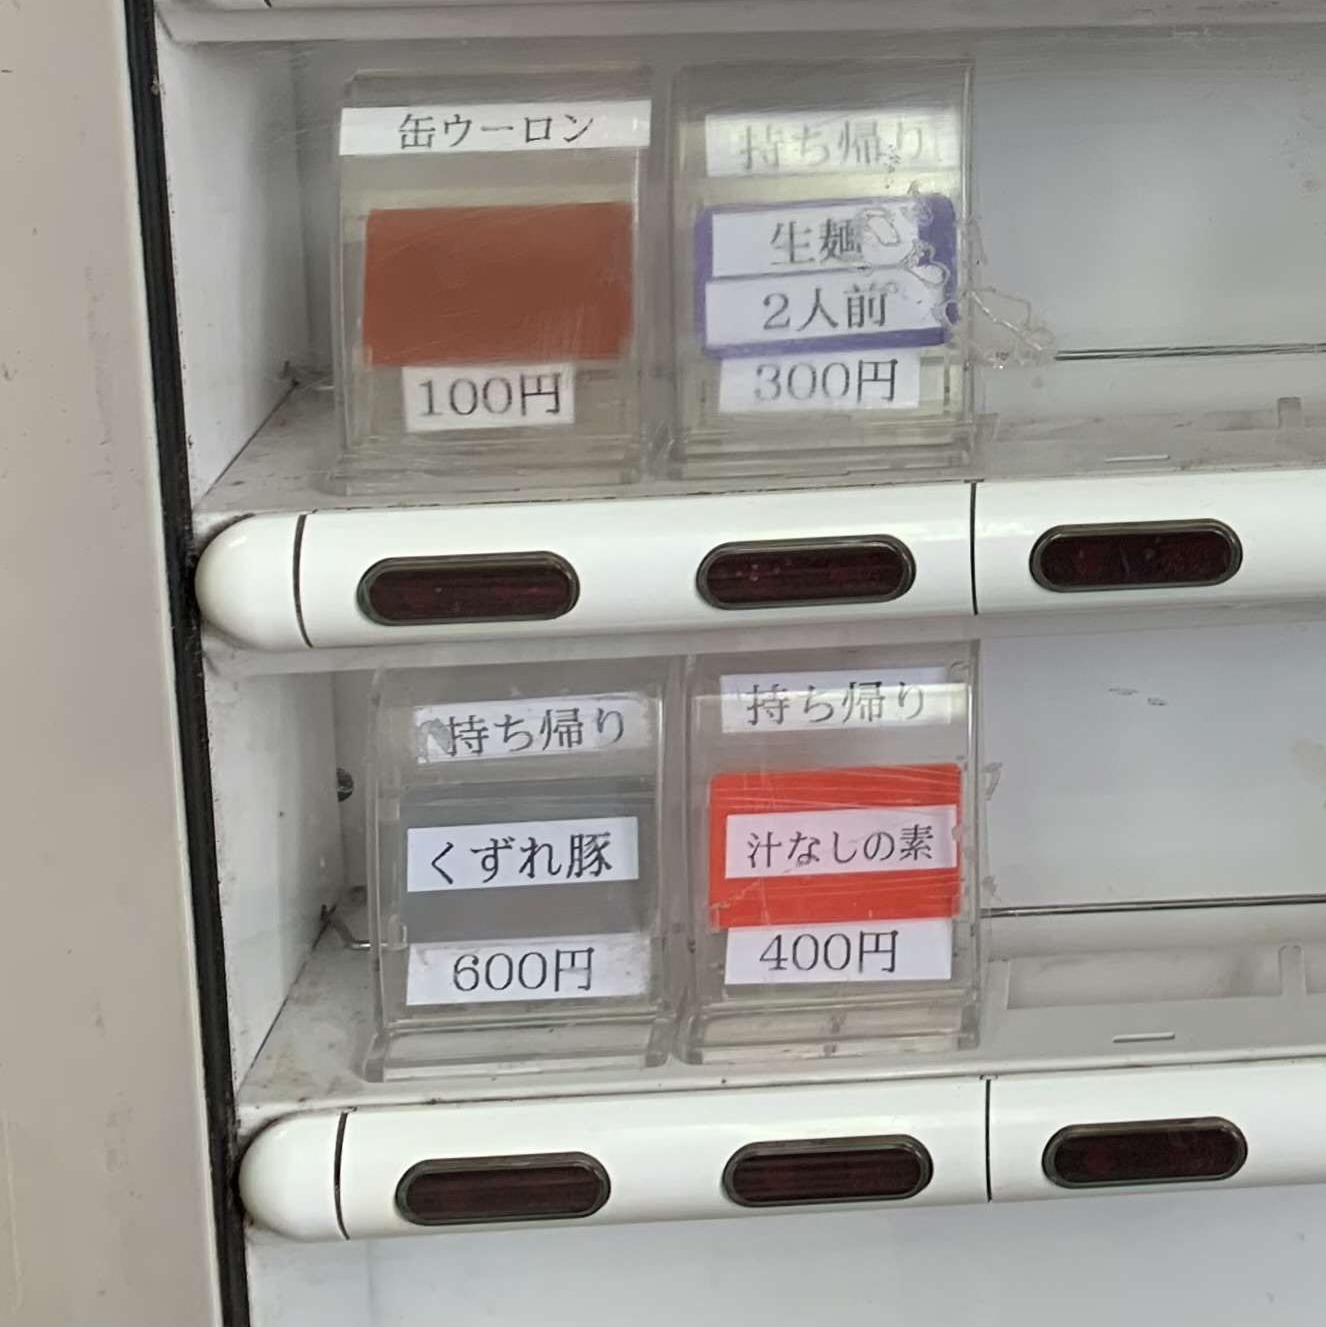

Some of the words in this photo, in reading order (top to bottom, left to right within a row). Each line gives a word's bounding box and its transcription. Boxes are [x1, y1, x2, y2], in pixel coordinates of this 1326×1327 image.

[399, 114, 594, 149] 缶ウーロン
[741, 120, 922, 170] 持ち帰り
[763, 286, 887, 330] 2人前
[421, 372, 561, 416] 100円
[755, 358, 898, 403] 300円
[746, 682, 924, 725] 持ち帰り
[449, 708, 624, 756] 持ち帰り
[431, 832, 612, 882] くずれ豚
[748, 824, 933, 868] 汁なしの素
[453, 947, 595, 992] 600円
[760, 930, 898, 973] 400円
